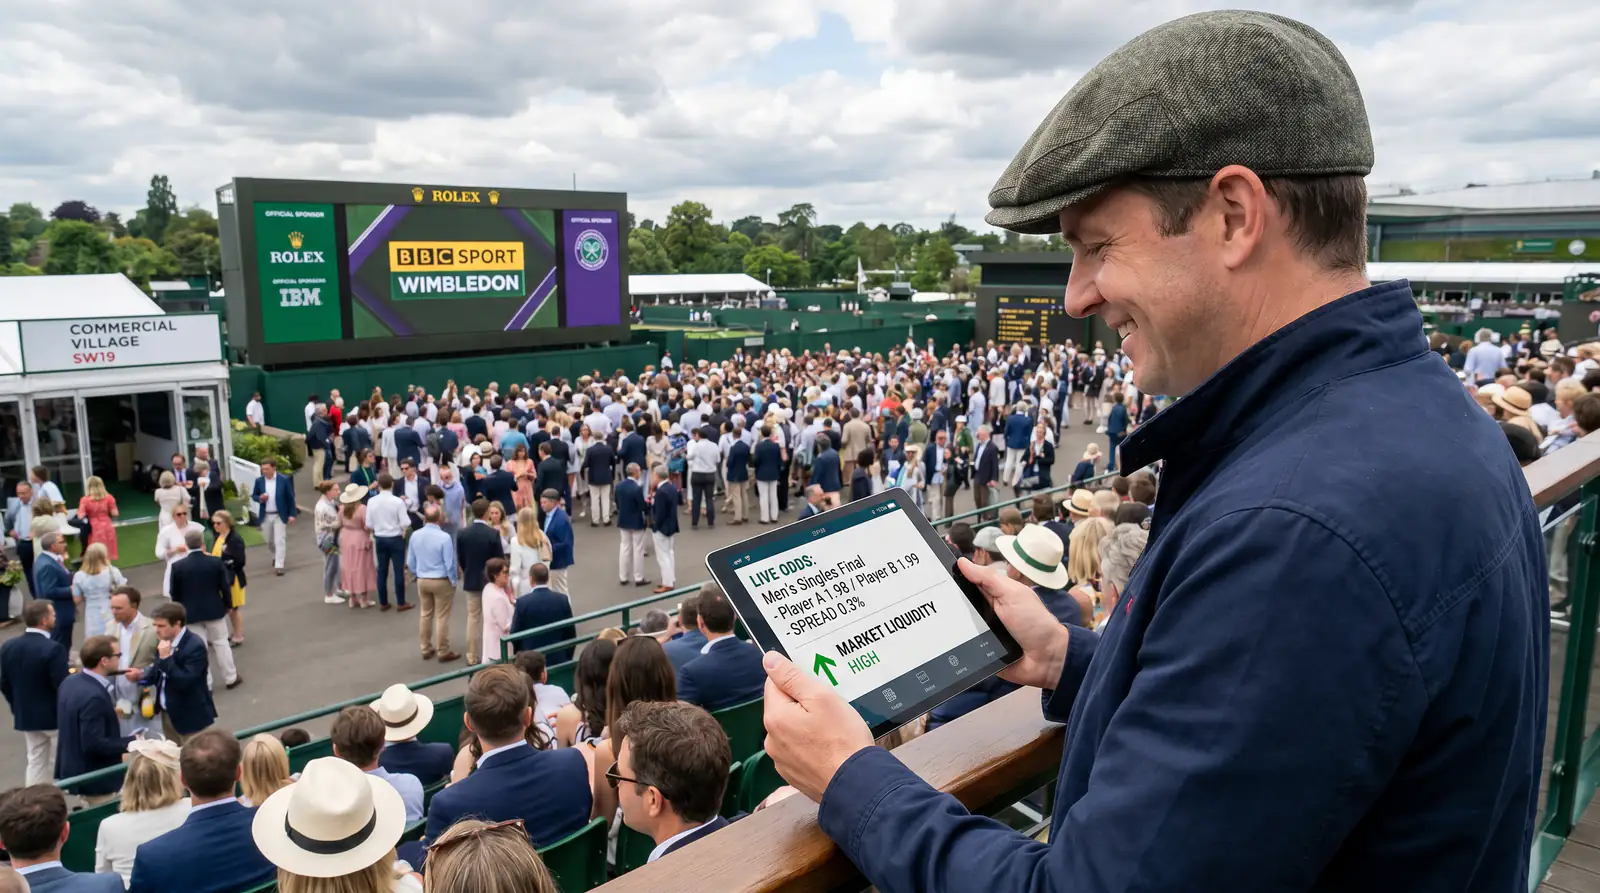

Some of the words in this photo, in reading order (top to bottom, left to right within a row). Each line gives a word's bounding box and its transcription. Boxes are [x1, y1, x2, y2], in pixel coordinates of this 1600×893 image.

[432, 190, 481, 203] ROLEX
[270, 251, 326, 263] ROLEX
[397, 248, 454, 265] BBC
[458, 249, 517, 264] SPORT
[398, 274, 519, 294] WIMBLEDON
[279, 288, 322, 307] IBM
[70, 320, 177, 336] COMMERCIAL
[71, 336, 140, 349] VILLAGE
[72, 351, 115, 364] SW19
[749, 567, 780, 588] LIVE
[779, 554, 817, 577] ODDS:
[761, 583, 798, 605] Men's
[796, 568, 839, 591] Singles
[837, 554, 866, 575] Final
[777, 597, 814, 620] Player
[815, 592, 826, 603] A
[823, 581, 850, 600] 1.98
[855, 566, 889, 588] Player
[887, 561, 898, 574] B
[896, 552, 920, 570] 1.99
[836, 596, 866, 615] 0.3%
[835, 625, 885, 657] MARKET
[884, 601, 937, 635] LIQUIDITY
[847, 650, 881, 674] HIGH
